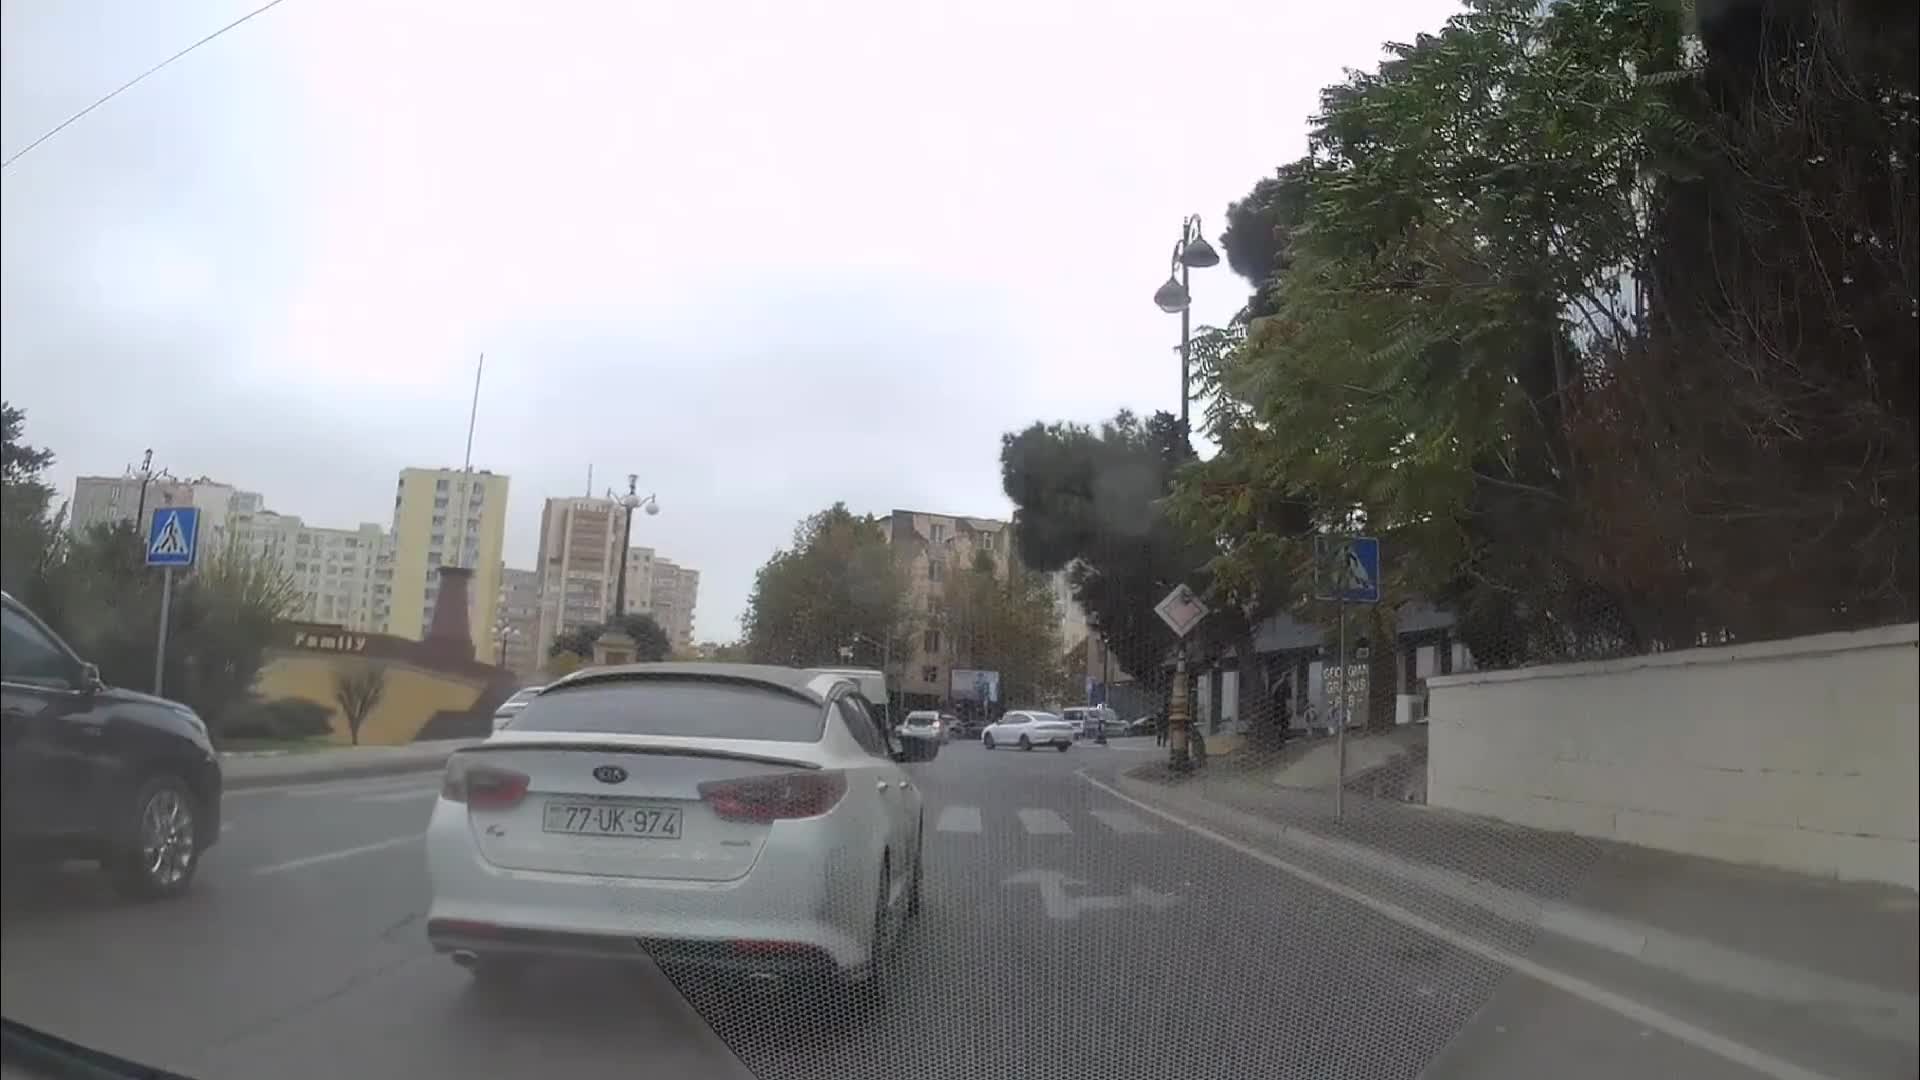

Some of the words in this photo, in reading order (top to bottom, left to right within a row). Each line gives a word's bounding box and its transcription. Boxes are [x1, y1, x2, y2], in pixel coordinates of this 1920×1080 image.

[296, 634, 366, 650] Family
[1324, 664, 1367, 680] GEOGIAN
[1328, 680, 1366, 693] GRDUS
[597, 767, 623, 781] KIA
[565, 807, 676, 834] 77-UK-974
